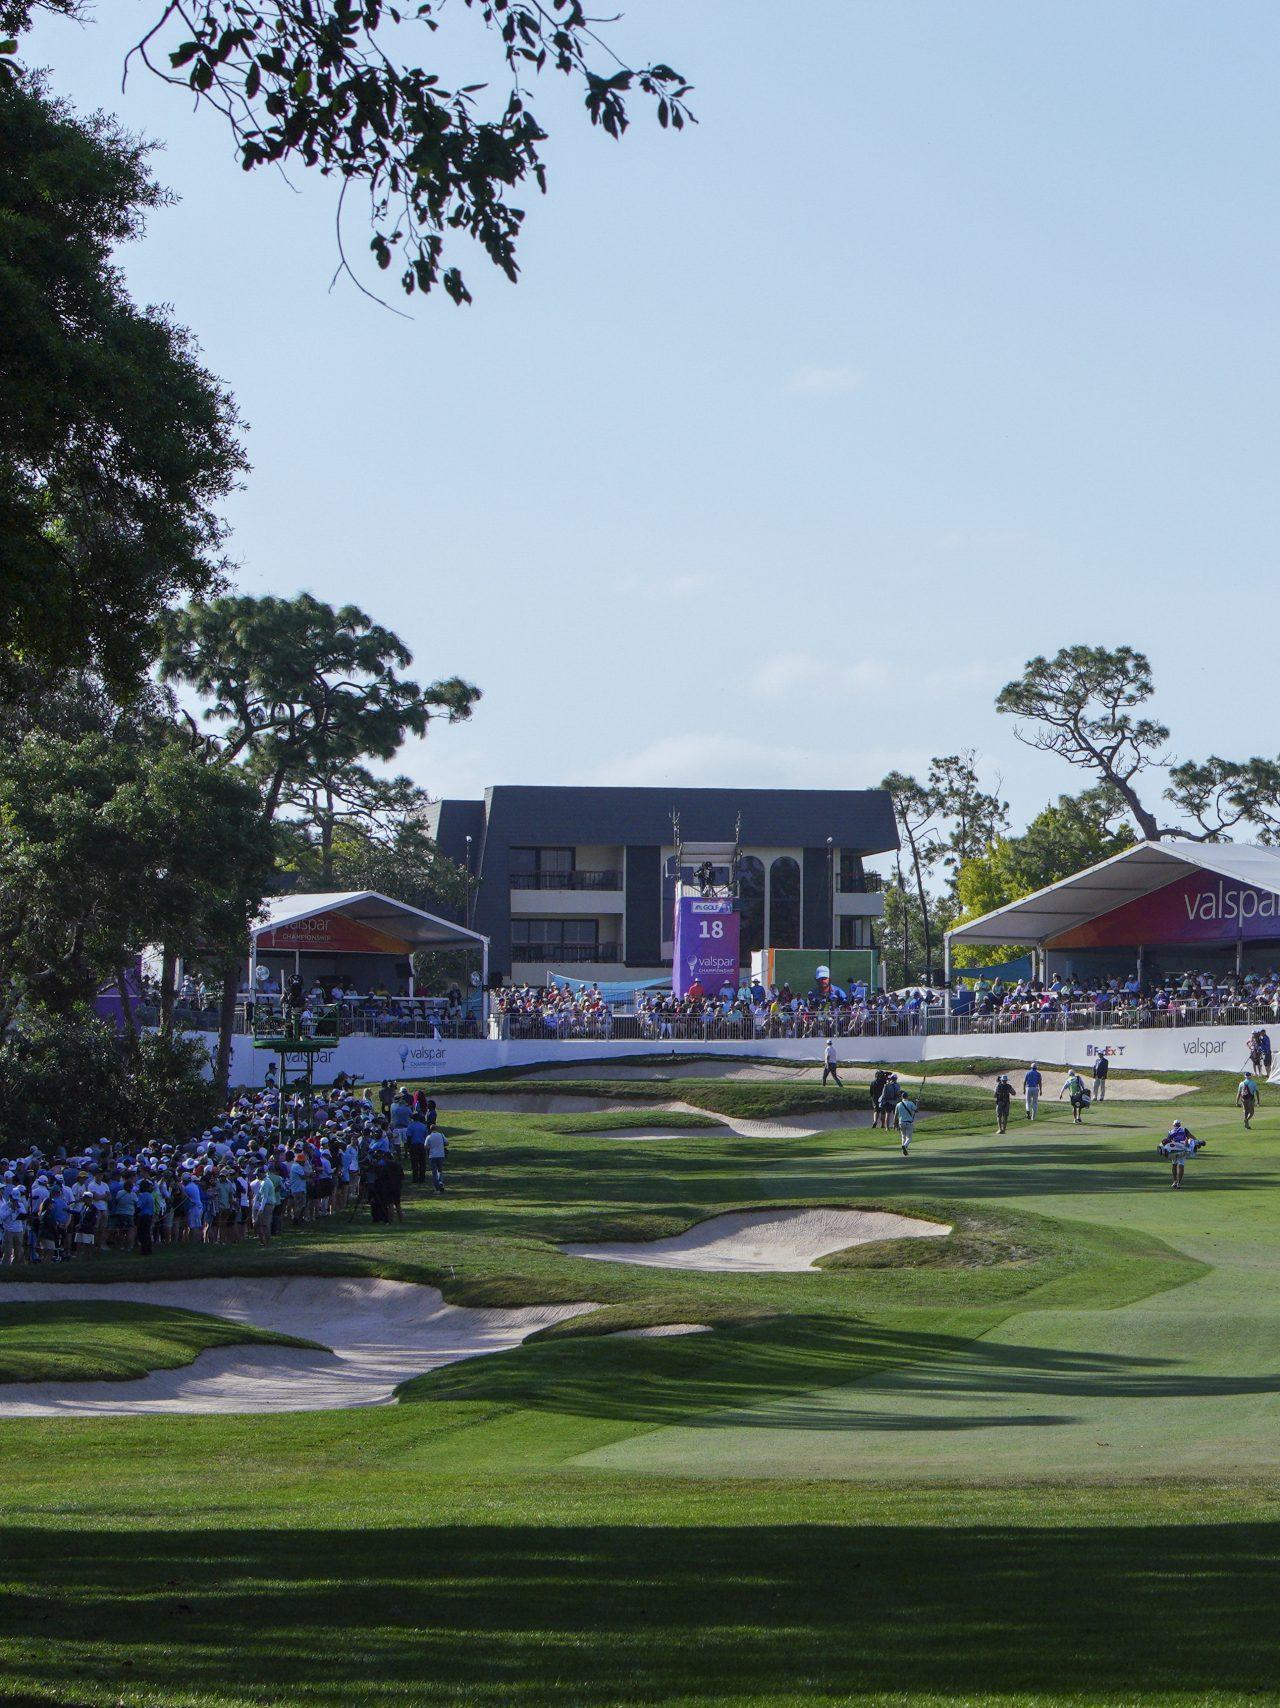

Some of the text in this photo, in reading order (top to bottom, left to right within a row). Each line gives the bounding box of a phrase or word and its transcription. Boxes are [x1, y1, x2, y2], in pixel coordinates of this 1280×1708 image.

[699, 921, 724, 938] 18
[282, 934, 332, 942] CHAMPIONSHIP
[698, 956, 735, 969] valspar
[410, 1045, 447, 1061] valspar
[1183, 1037, 1227, 1058] valspar
